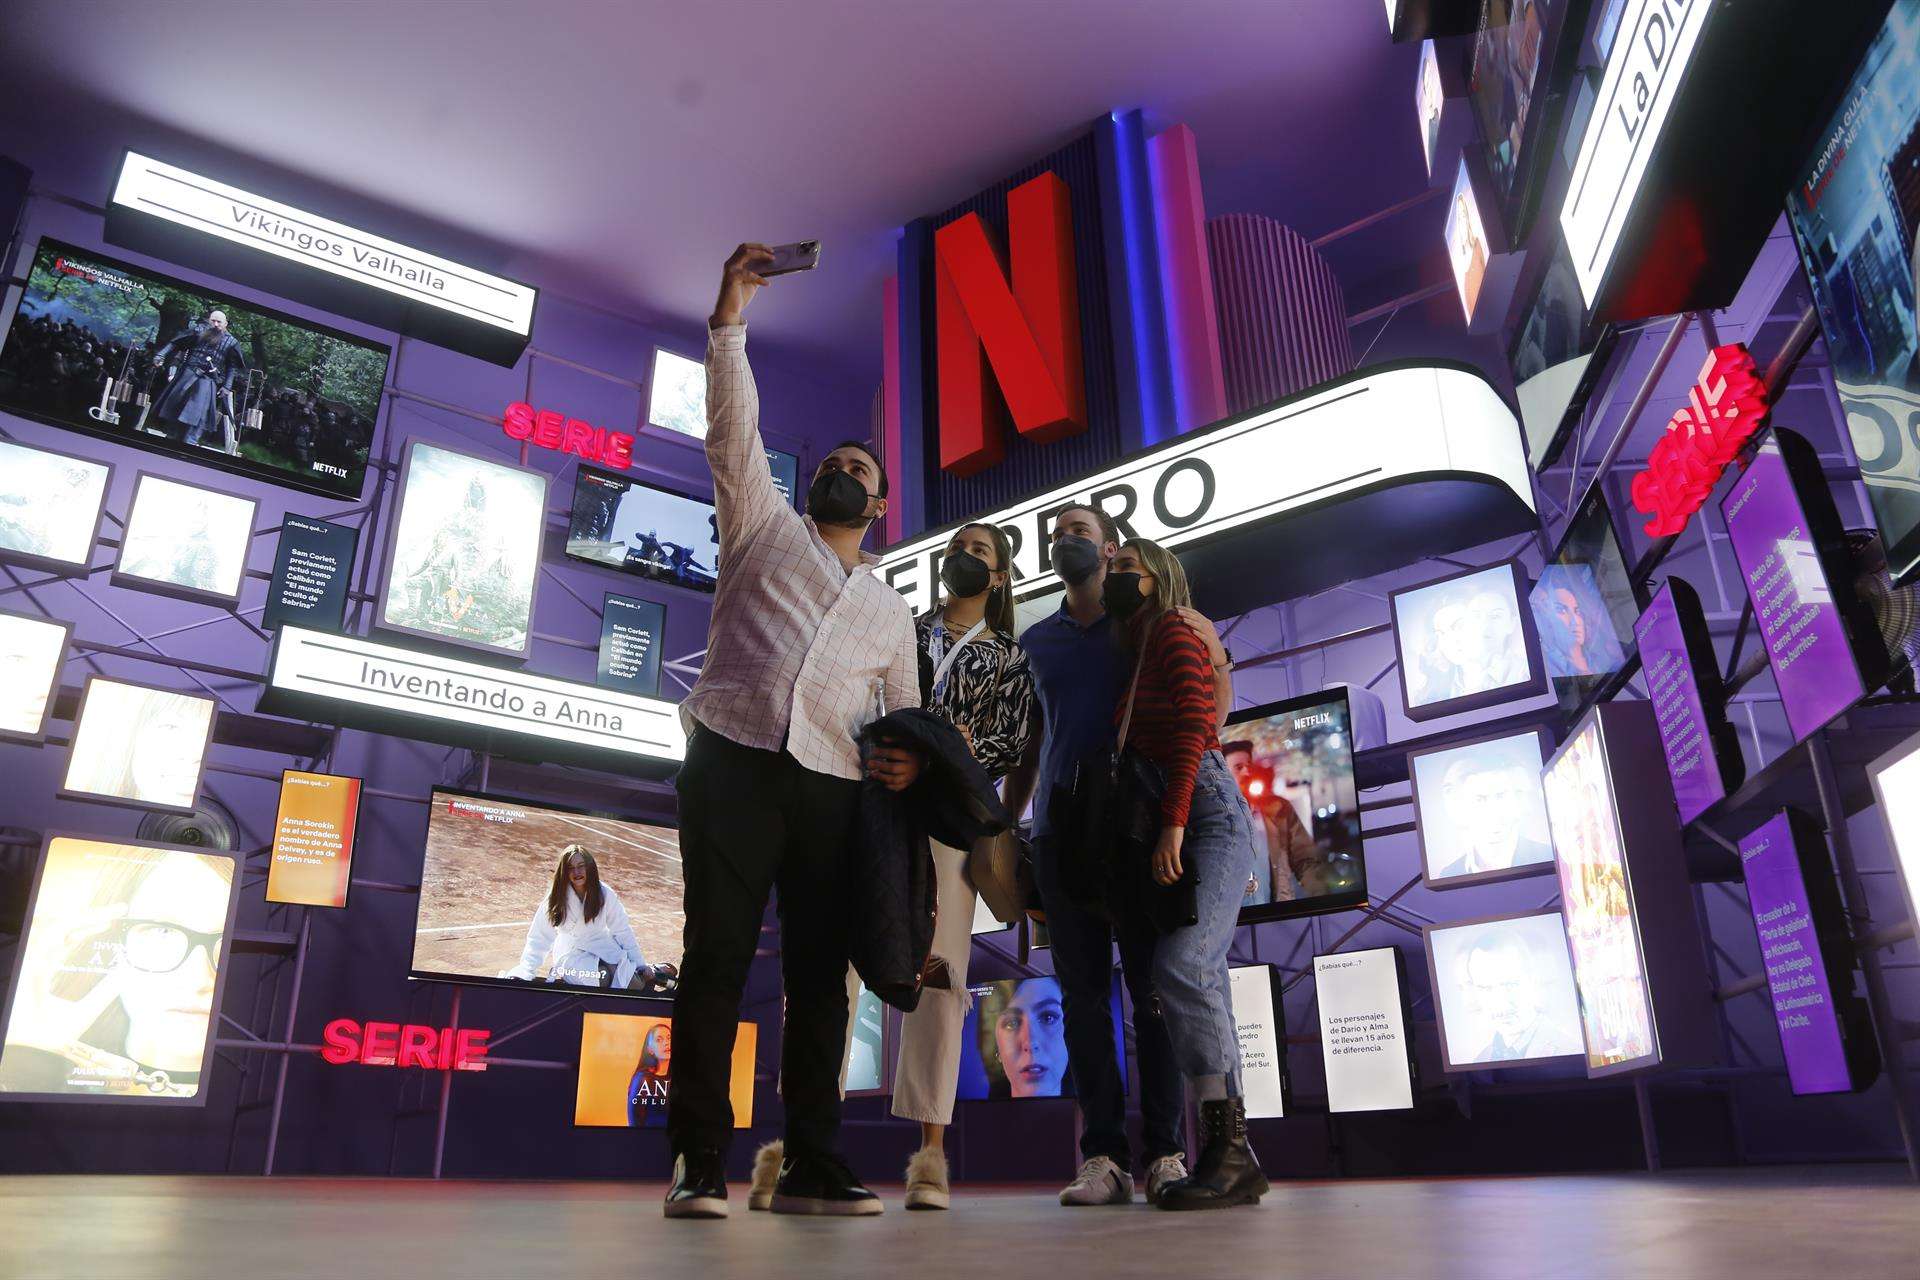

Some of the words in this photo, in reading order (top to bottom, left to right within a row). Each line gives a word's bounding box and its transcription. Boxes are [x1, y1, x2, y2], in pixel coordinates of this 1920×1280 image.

[1619, 71, 1649, 142] La
[1817, 126, 1845, 173] DIVINA
[1843, 86, 1868, 126] GULA
[232, 206, 343, 257] Vikingos
[353, 247, 445, 290] Valhalla
[63, 260, 104, 277] VIKINGOS
[104, 273, 144, 290] VALHALLA
[98, 277, 132, 293] NETFLIX
[934, 169, 1088, 480] N
[503, 401, 636, 471] SERIE
[312, 461, 348, 479] NETFLIX
[292, 548, 308, 557] Sam
[309, 552, 337, 565] Corlett,
[290, 557, 336, 572] previamente
[288, 565, 310, 574] actuó
[310, 570, 331, 579] como
[283, 590, 307, 600] oculto
[298, 585, 324, 595] mundo
[1790, 601, 1820, 637] llevaban
[613, 624, 627, 632] Sam
[612, 632, 650, 645] previamente
[621, 657, 642, 665] mundo
[361, 661, 524, 713] Inventando
[533, 701, 546, 717] a
[555, 701, 623, 731] Anna
[1294, 712, 1330, 730] NETFLIX
[453, 801, 499, 814] INVENTANDO
[505, 809, 526, 818] ANNA
[282, 817, 304, 826] Anna
[304, 819, 335, 830] Sorokin
[484, 814, 513, 823] NETFLIX
[300, 829, 340, 839] verdadero
[280, 836, 310, 845] nombre
[311, 838, 321, 846] de
[322, 841, 343, 849] Anna
[277, 854, 302, 864] origen
[303, 857, 324, 865] ruso.
[325, 849, 336, 857] de
[551, 967, 577, 977] ¿Qué
[578, 970, 607, 979] pasa?
[1344, 1013, 1385, 1024] personajes
[1238, 1022, 1262, 1031] puedes
[321, 1018, 491, 1072] SERIE
[1341, 1036, 1363, 1044] llevan
[1377, 1033, 1396, 1041] años
[1343, 1044, 1384, 1054] diferencia.
[637, 1080, 670, 1097] AN
[632, 1097, 666, 1105] CHLU
